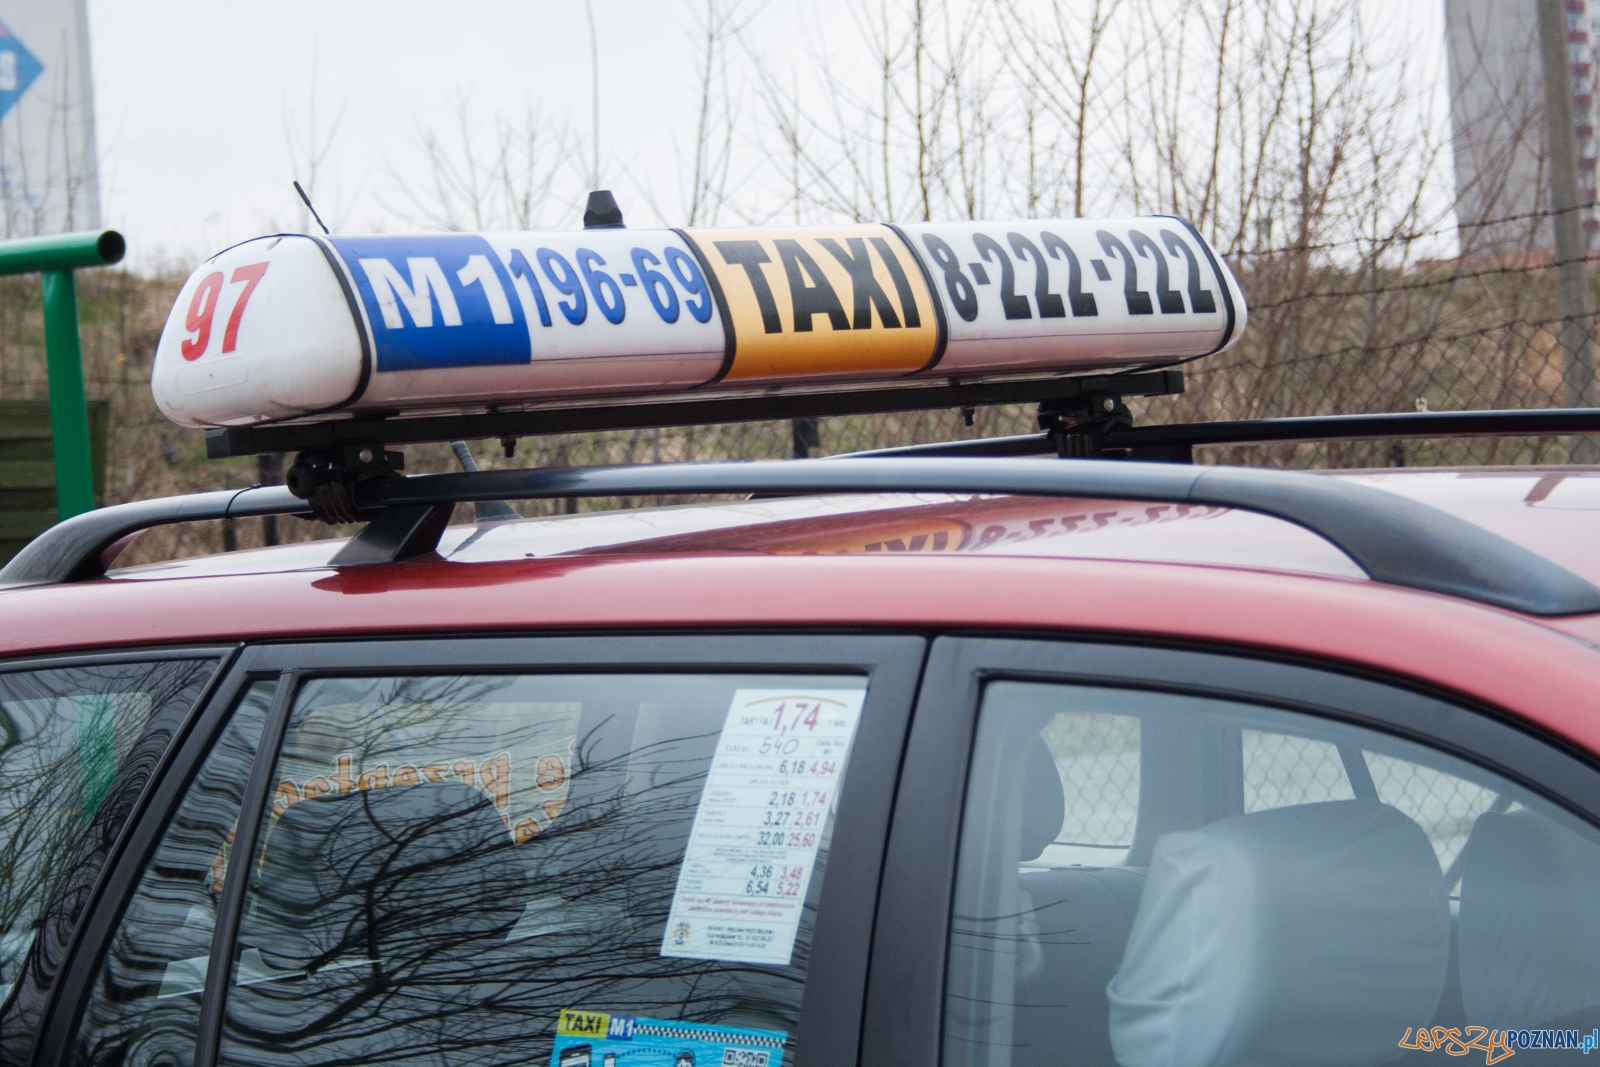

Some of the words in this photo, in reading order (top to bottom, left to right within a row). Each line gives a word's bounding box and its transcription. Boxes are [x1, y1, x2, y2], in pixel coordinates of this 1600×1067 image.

[921, 229, 1217, 323] 8-222-222
[358, 254, 514, 330] M1
[508, 246, 713, 327] 196-69
[713, 237, 922, 335] TAXI
[180, 261, 270, 362] 97
[773, 702, 821, 737] 1,74
[758, 736, 800, 755] 540
[779, 759, 806, 777] 6,18
[810, 760, 837, 777] 4,94
[769, 791, 796, 808] 2,18
[802, 791, 827, 808] 1,74
[763, 811, 791, 827] 3,27
[794, 811, 821, 828] 2,61
[757, 831, 786, 848] 32,00
[787, 832, 816, 848] 25,60
[750, 866, 773, 880] 4,36
[780, 866, 803, 881] 3,48
[746, 880, 770, 897] 6,54
[776, 881, 800, 897] 5,22
[564, 1013, 602, 1034] TAXI
[609, 1017, 635, 1037] M1
